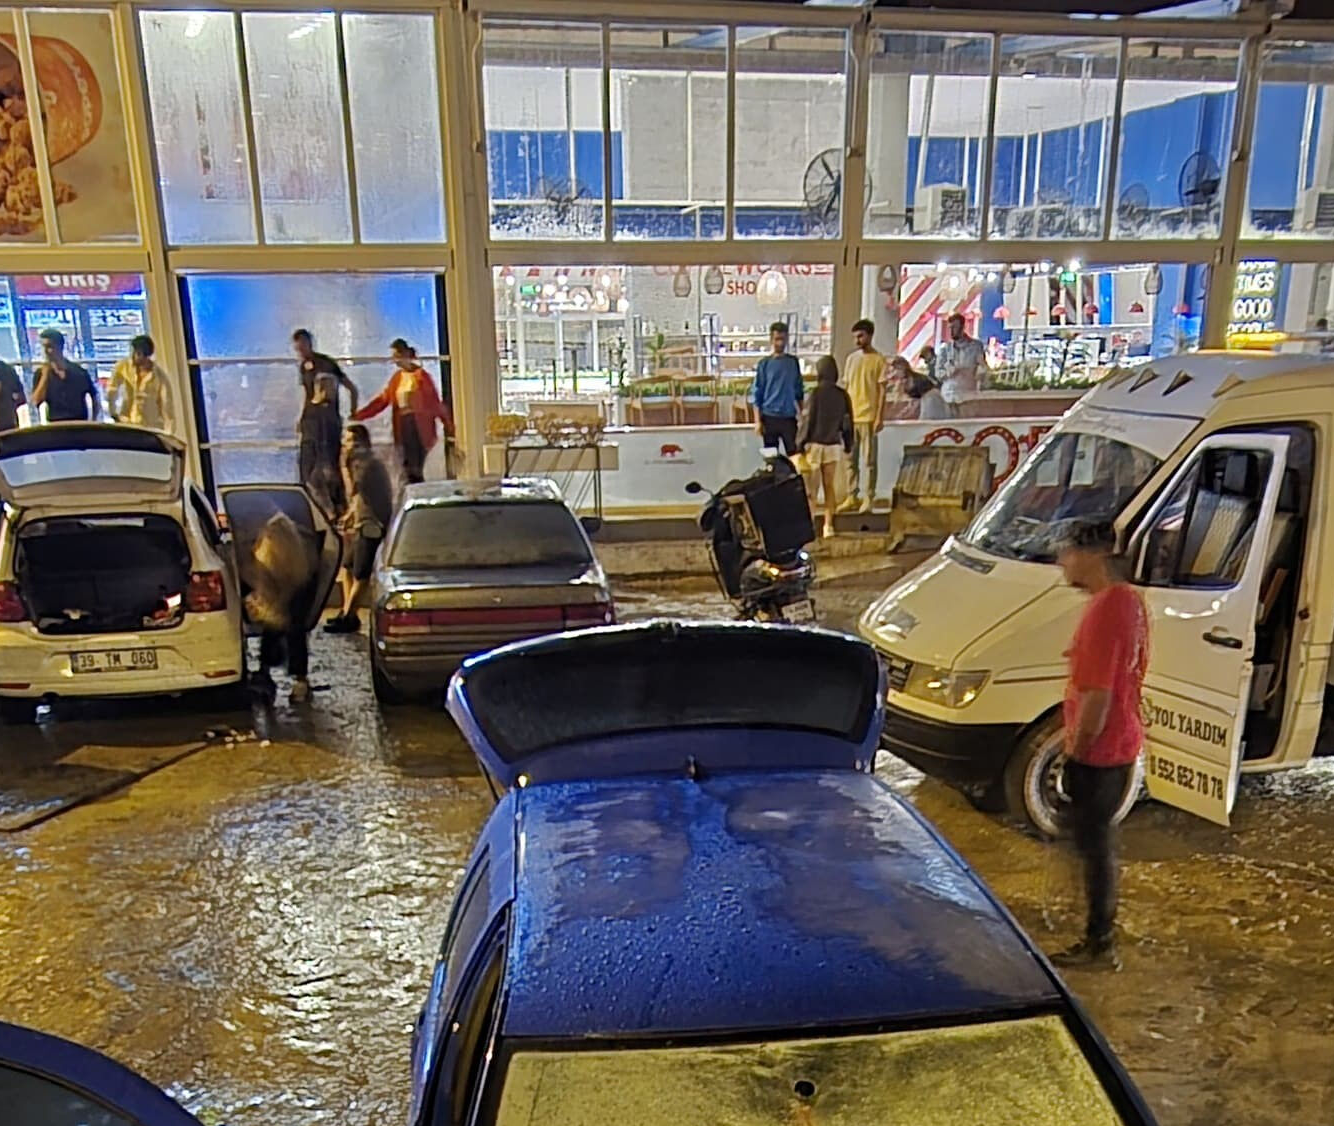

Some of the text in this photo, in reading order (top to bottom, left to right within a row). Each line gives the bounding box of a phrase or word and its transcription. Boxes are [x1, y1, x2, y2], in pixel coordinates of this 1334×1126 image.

[726, 280, 756, 295] SHO
[1154, 705, 1228, 748] YOL YARDIM
